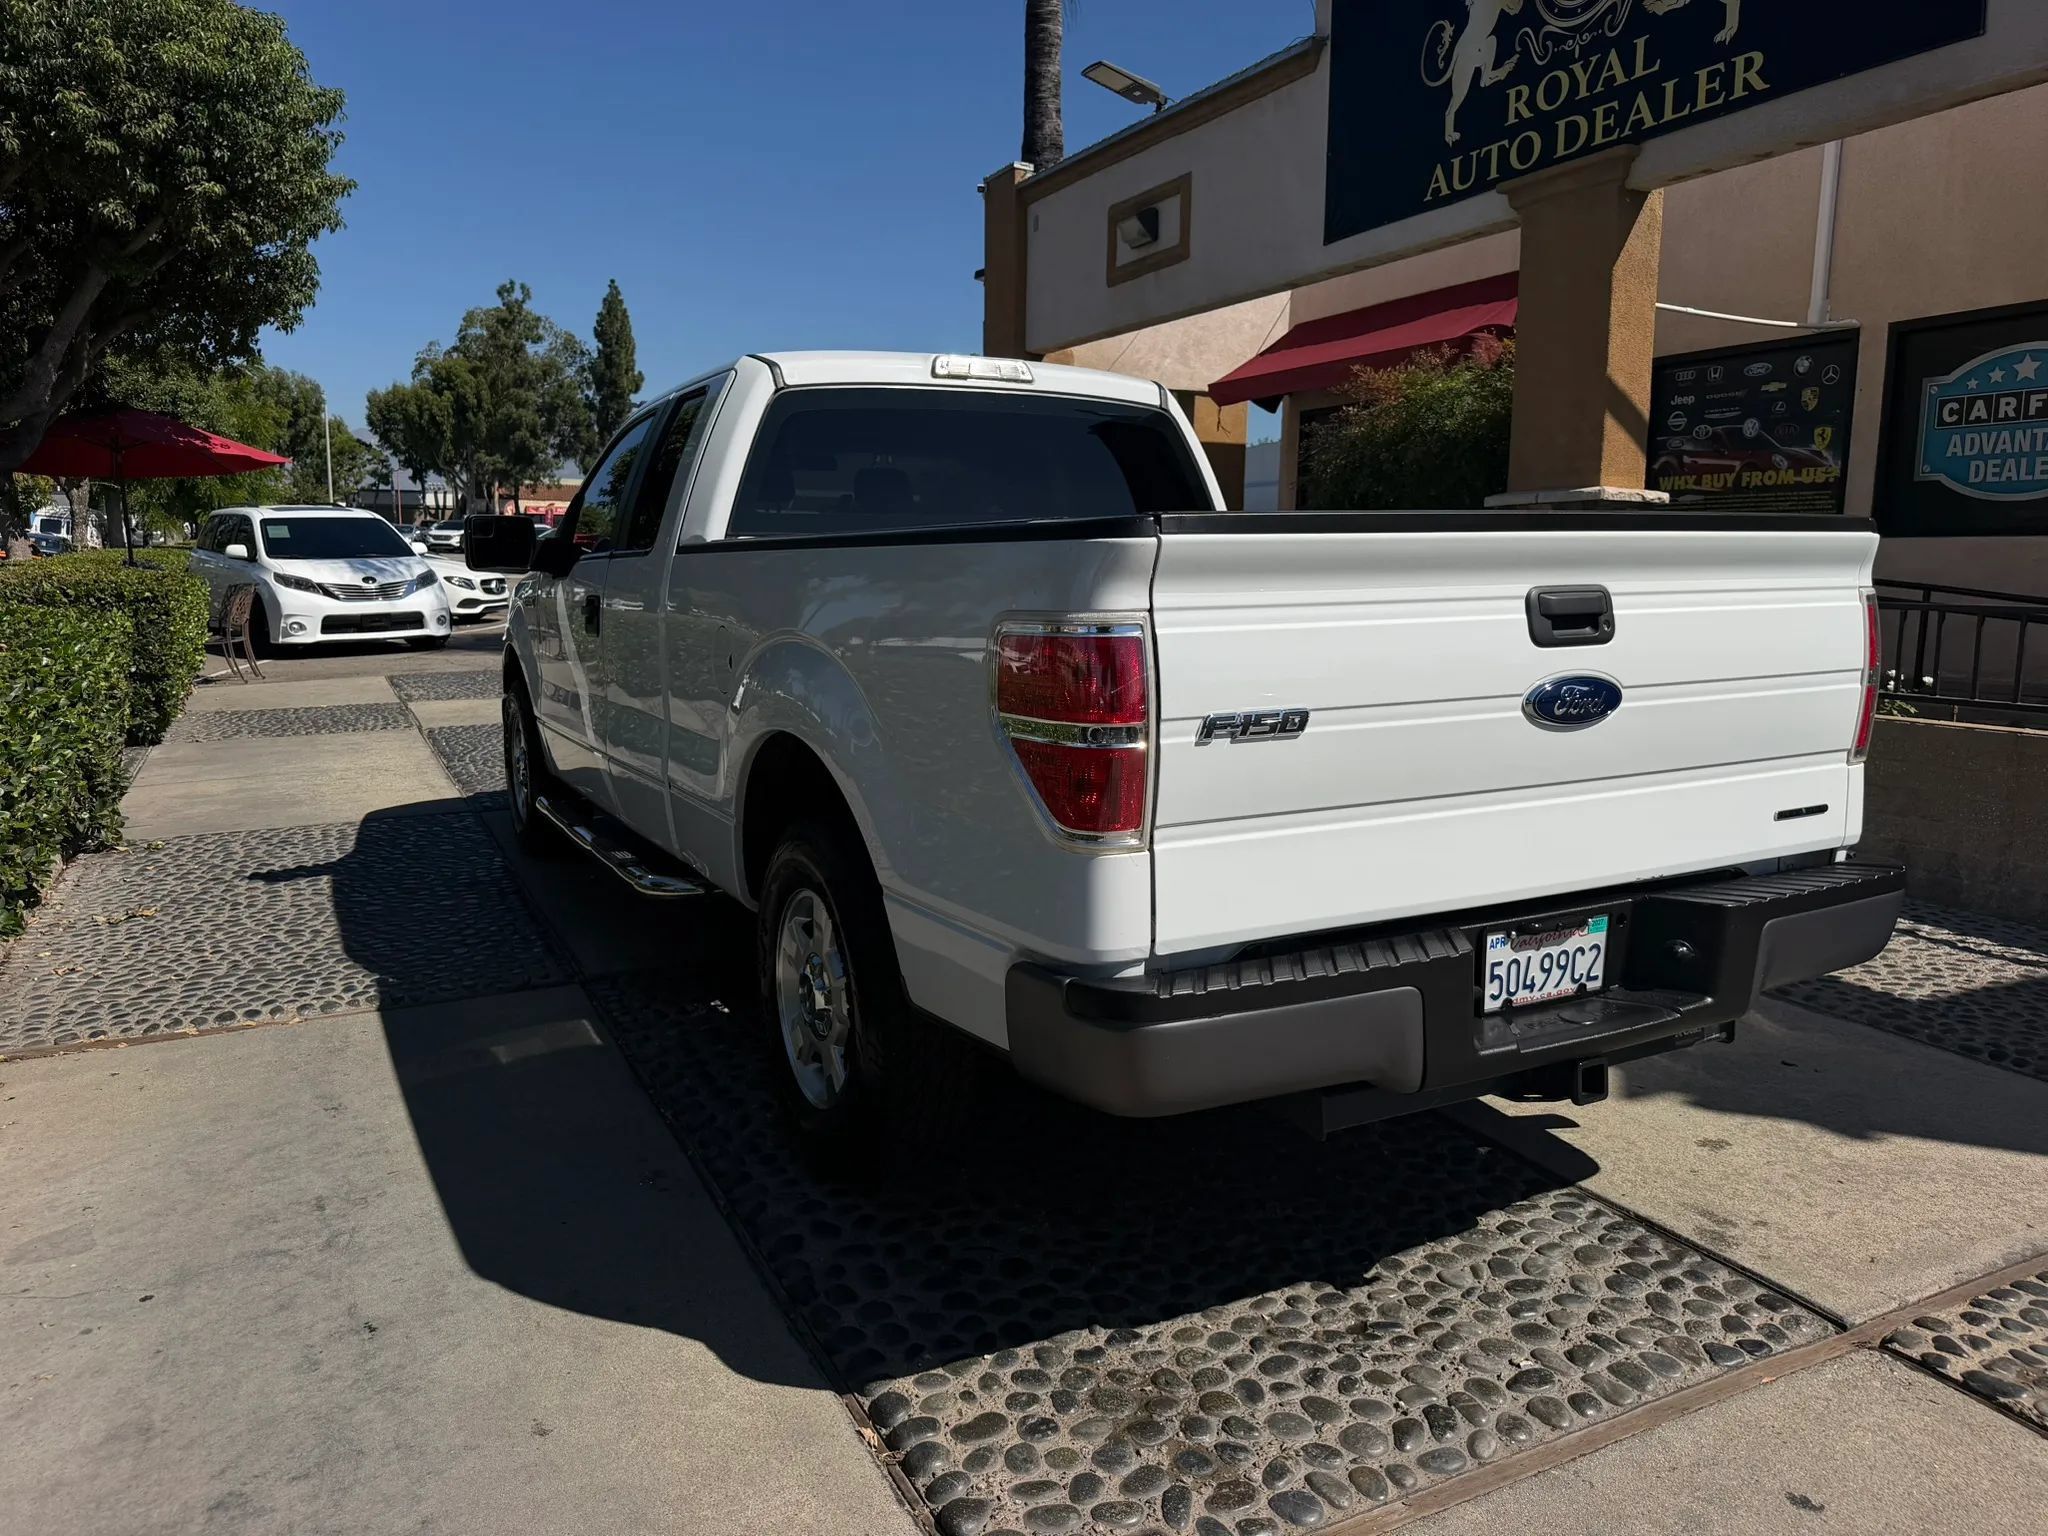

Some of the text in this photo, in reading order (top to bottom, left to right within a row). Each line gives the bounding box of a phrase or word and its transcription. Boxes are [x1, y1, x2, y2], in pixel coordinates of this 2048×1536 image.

[1504, 35, 1660, 126] ROYAL
[1424, 51, 1770, 200] AUTO DEALER
[1671, 394, 1695, 406] Jeep
[1946, 427, 2048, 457] ADVANT
[1659, 467, 1840, 491] WHY BUY FROM US?
[1553, 685, 1606, 716] Ford
[1195, 708, 1311, 746] F-150
[1489, 936, 1506, 950] APR
[1489, 943, 1601, 1001] 50499C2
[1512, 987, 1576, 1004] dmv.ca.gov
